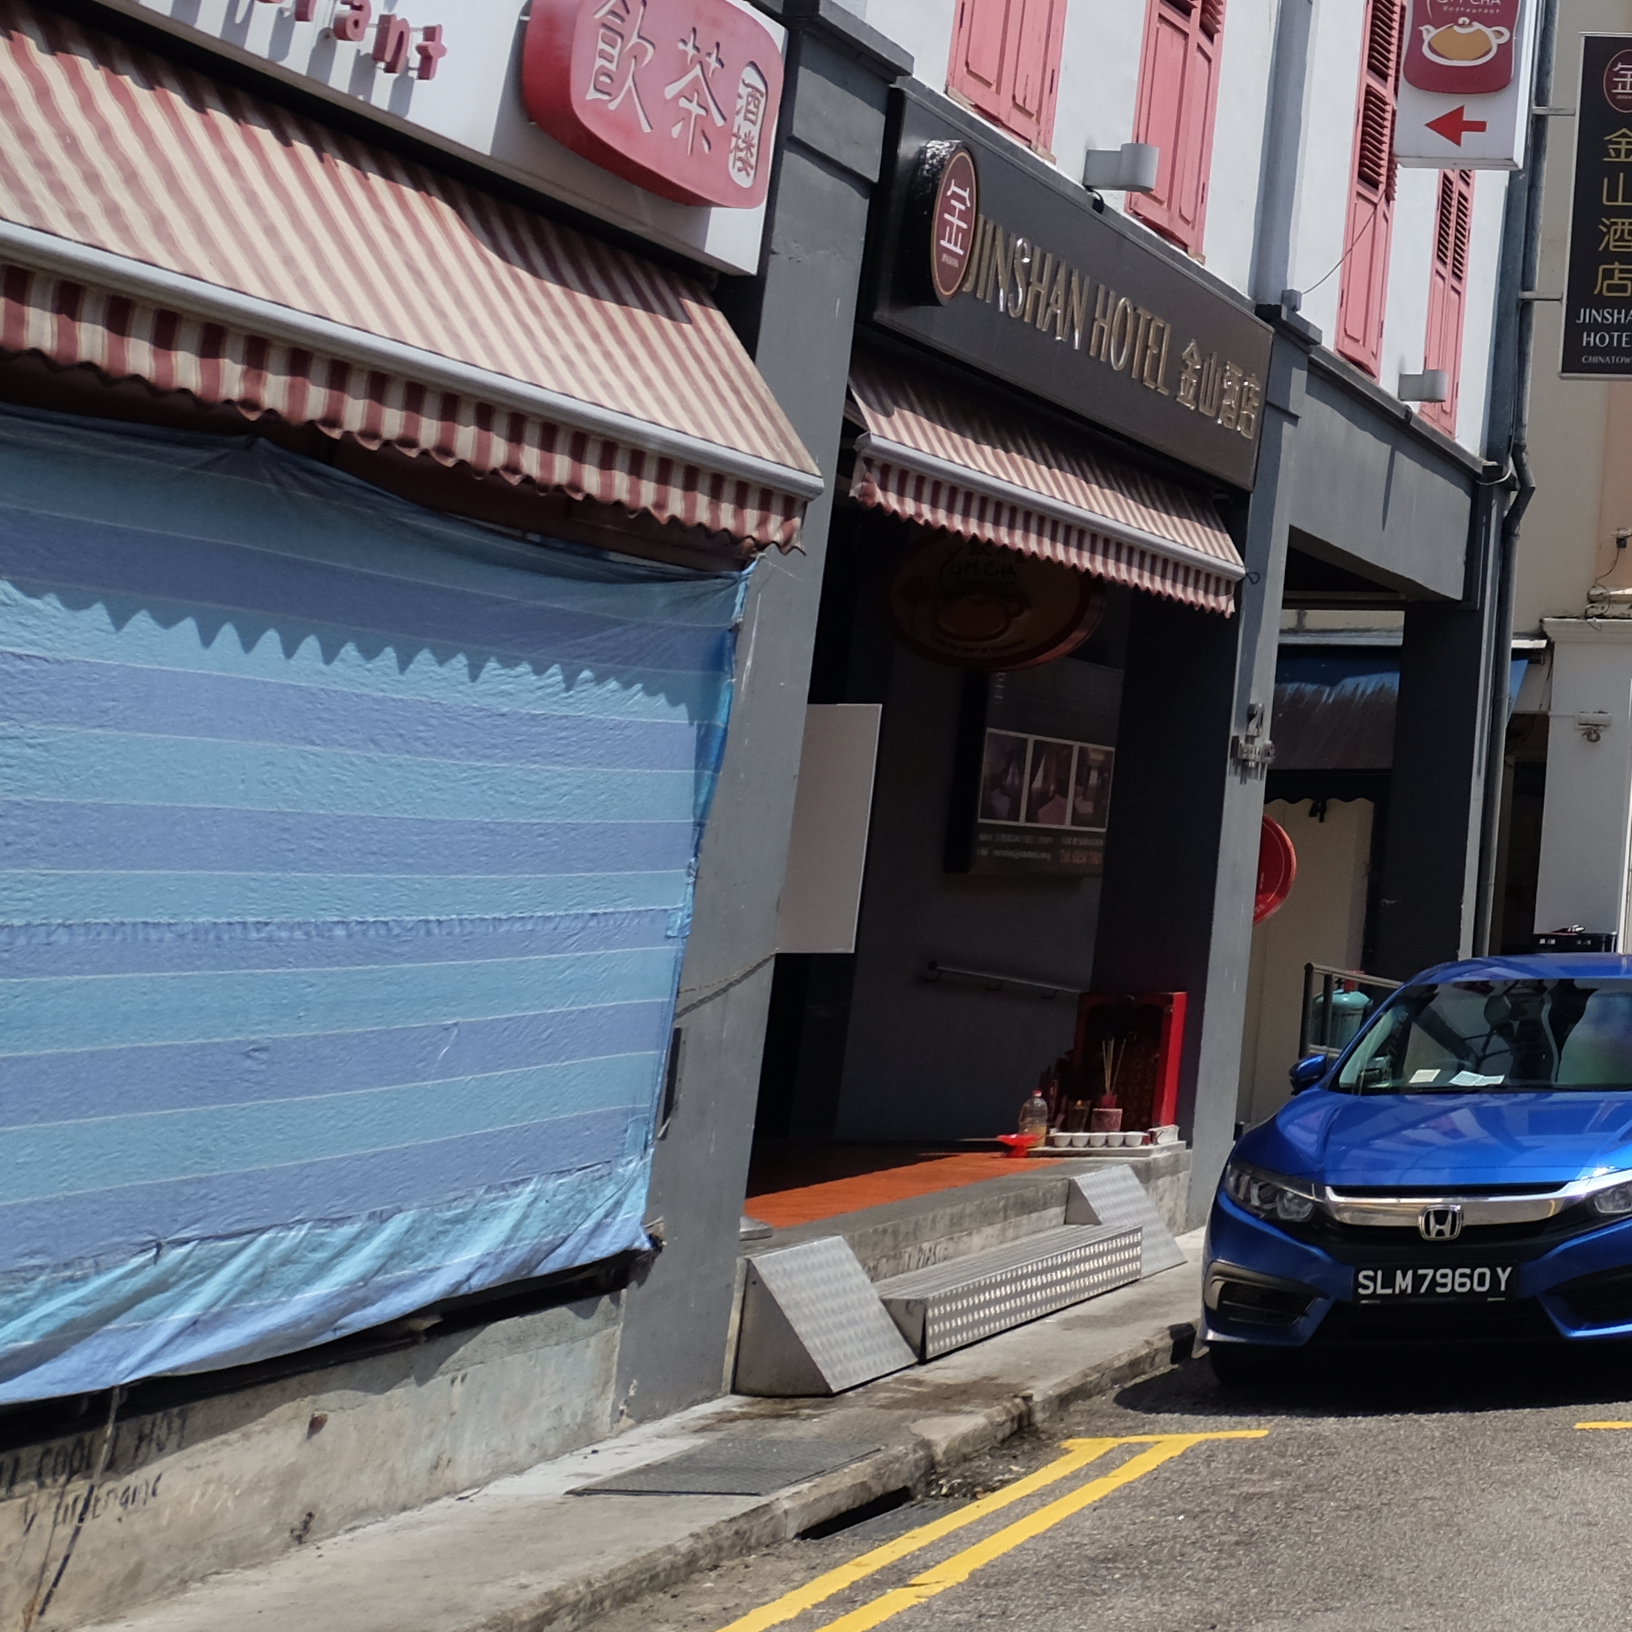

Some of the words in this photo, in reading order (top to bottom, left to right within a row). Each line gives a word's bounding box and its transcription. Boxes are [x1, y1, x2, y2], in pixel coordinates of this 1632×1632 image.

[962, 212, 1090, 350] JINSHAN
[1089, 284, 1173, 396] HOTEL
[1176, 338, 1261, 440] 金山酒店
[1355, 1265, 1514, 1297] SLM7960Y
